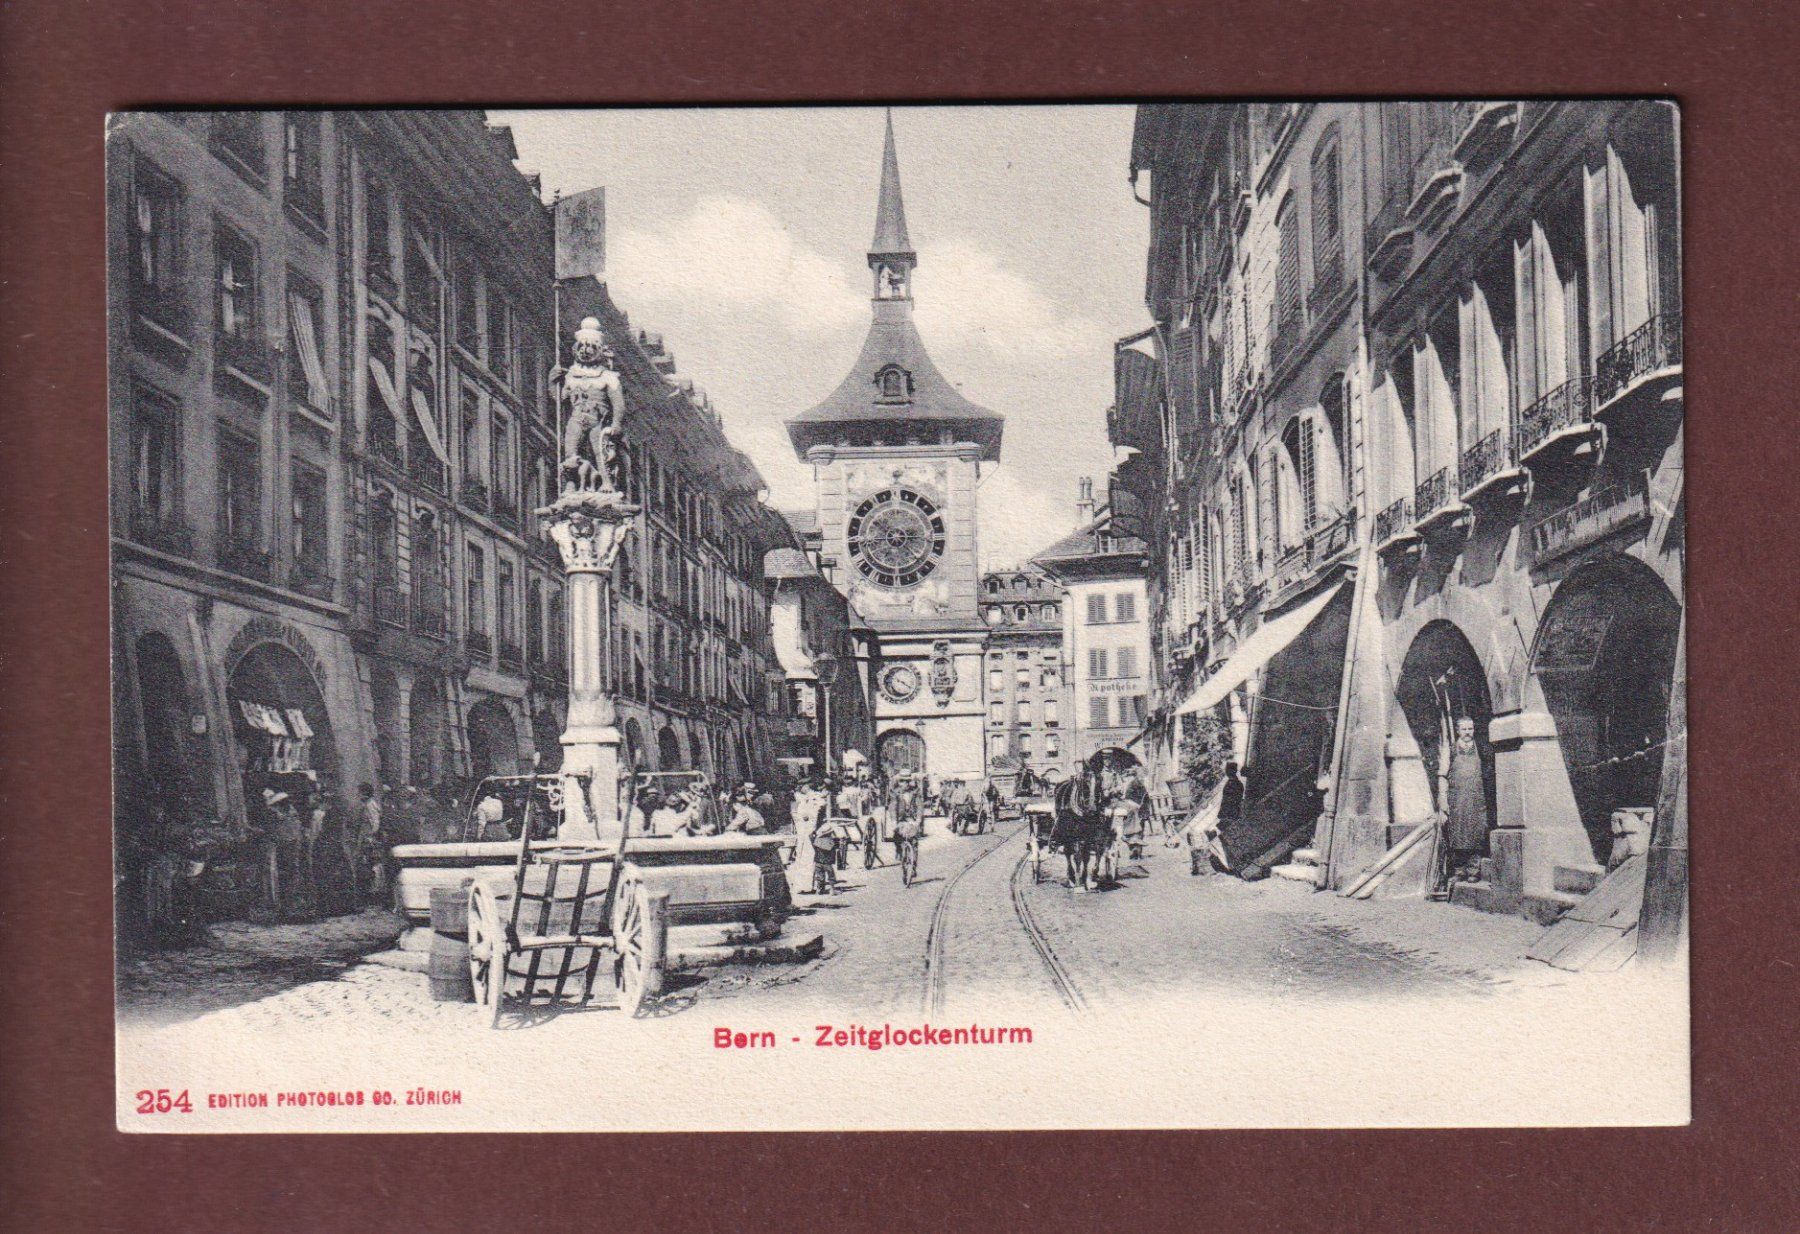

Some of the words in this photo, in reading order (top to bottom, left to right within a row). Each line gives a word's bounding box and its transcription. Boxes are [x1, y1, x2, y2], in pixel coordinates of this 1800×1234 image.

[1088, 681, 1137, 692] Apotheke
[712, 1026, 775, 1049] Bern
[815, 1023, 1033, 1051] Zeitglockenturm
[135, 1088, 193, 1115] 254
[207, 1092, 268, 1109] EDITION
[276, 1089, 364, 1107] PHOTOGLOB
[405, 1086, 462, 1105] ZÜRICH
